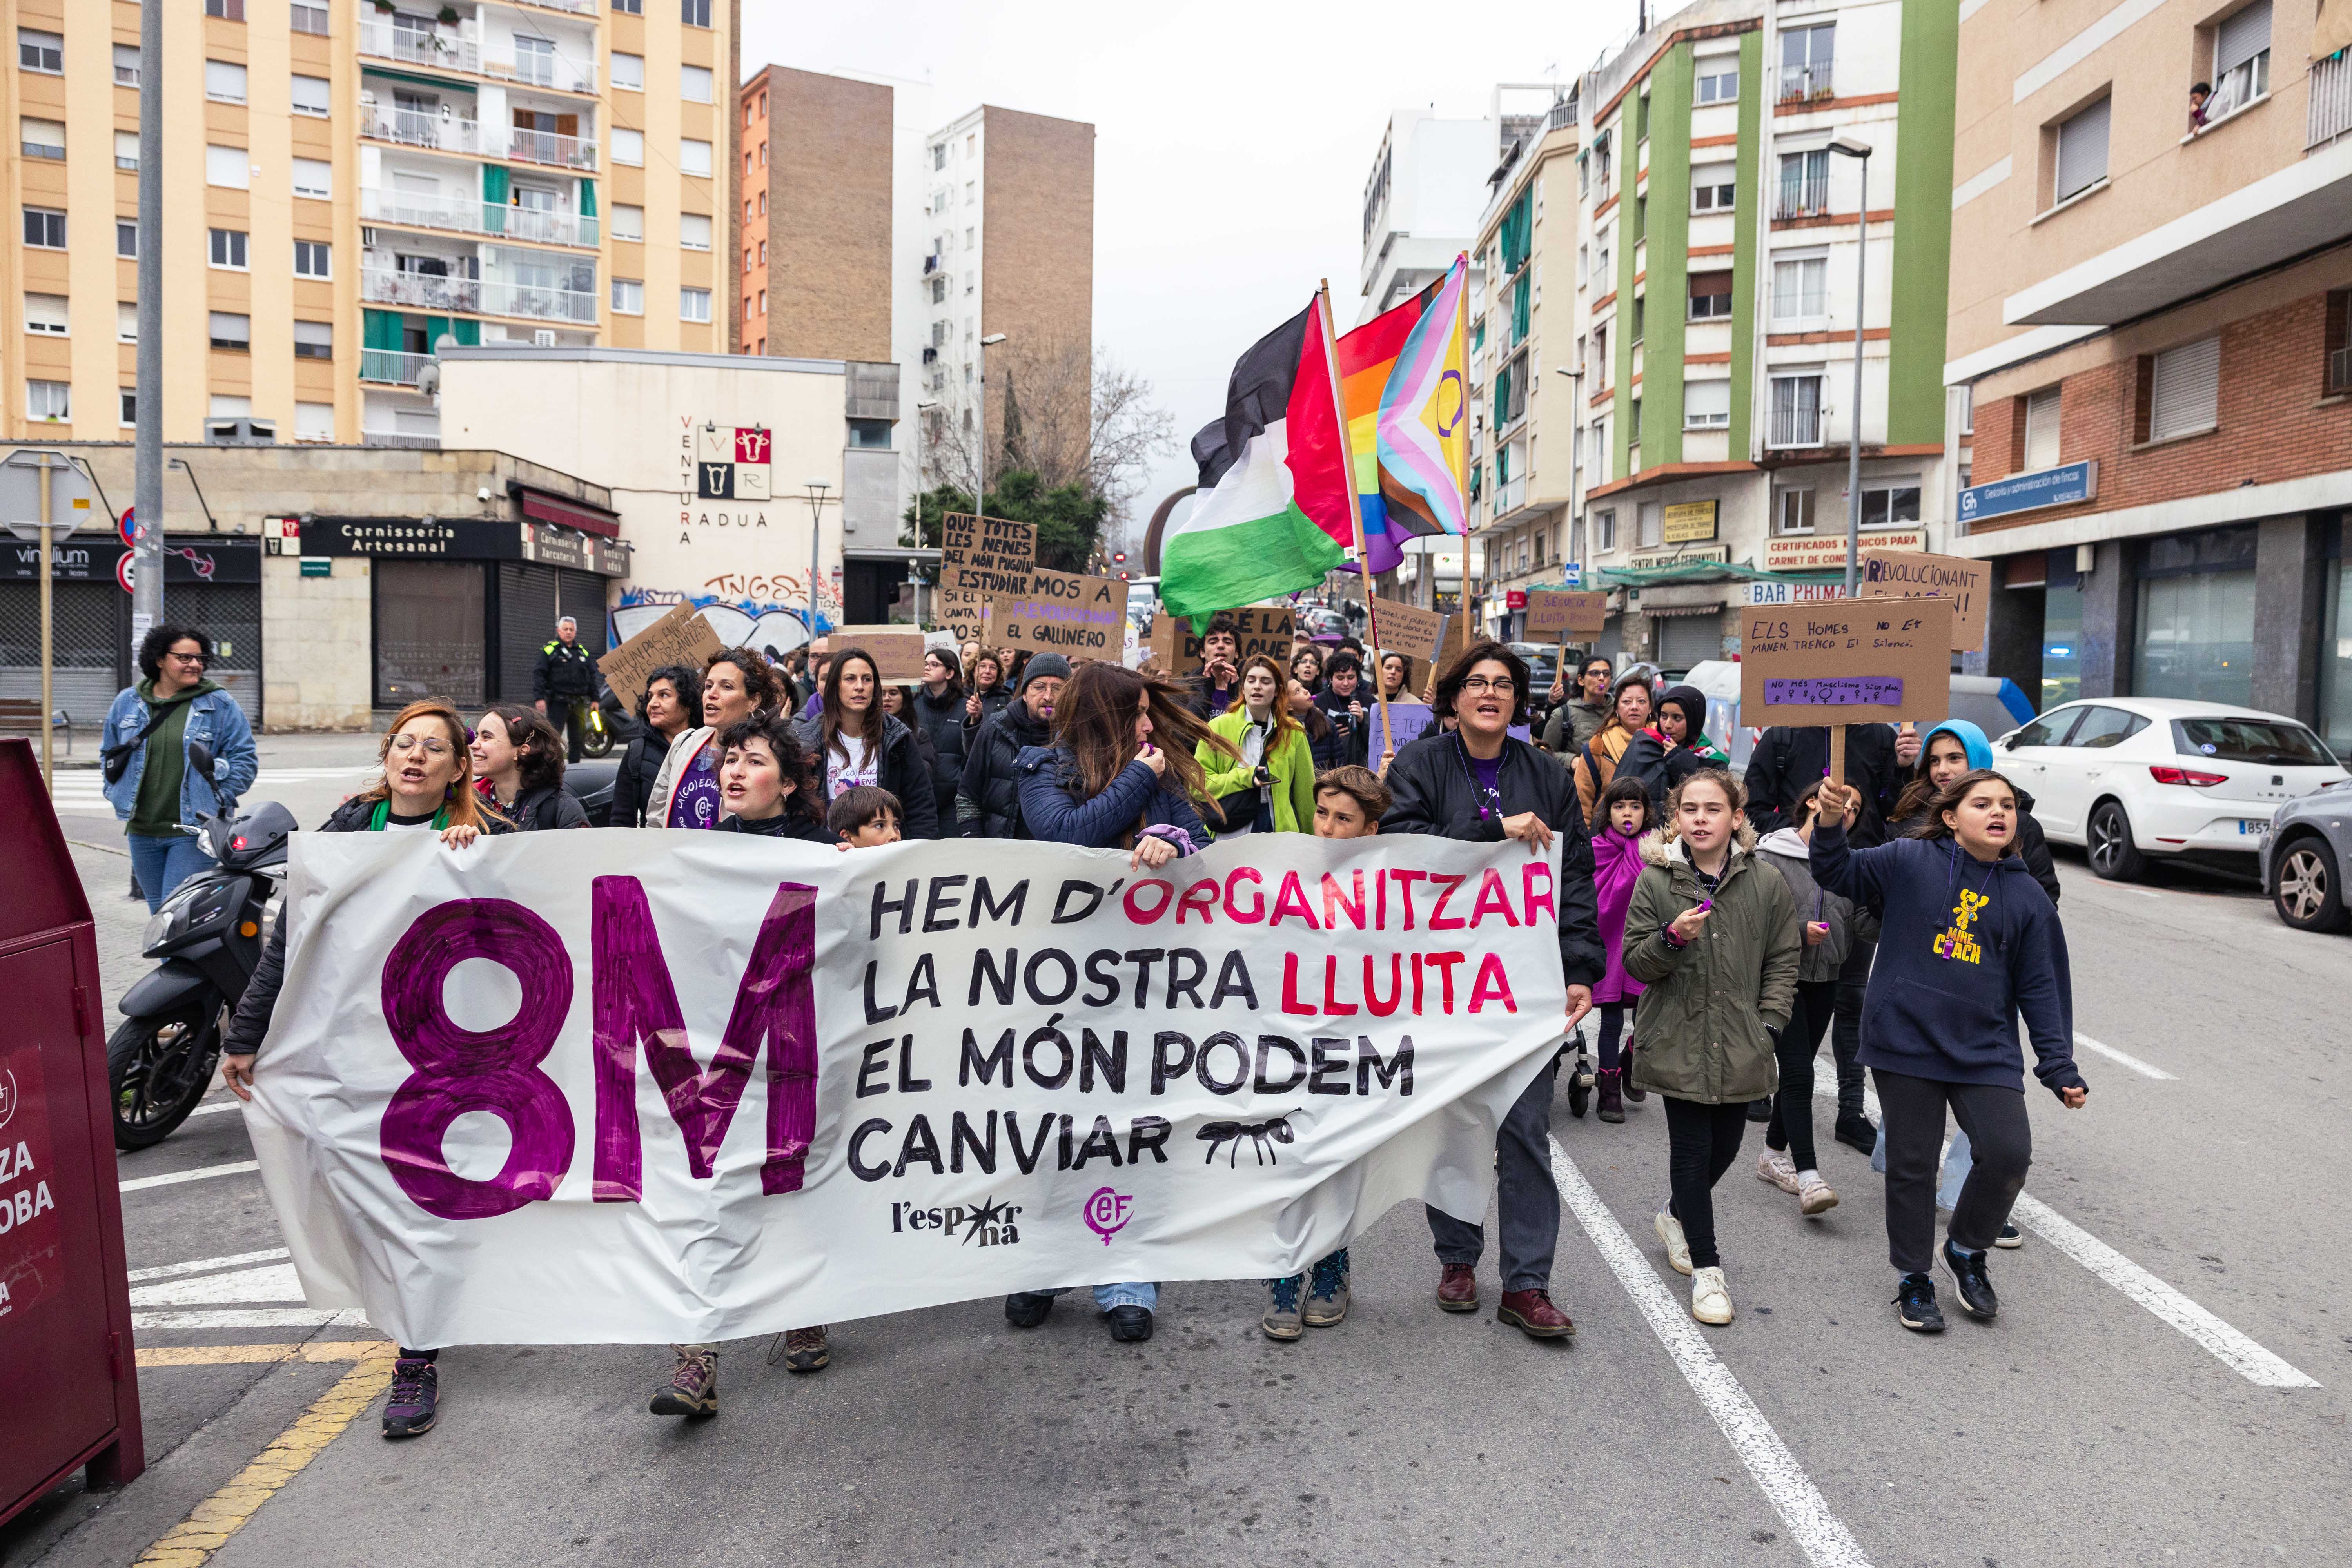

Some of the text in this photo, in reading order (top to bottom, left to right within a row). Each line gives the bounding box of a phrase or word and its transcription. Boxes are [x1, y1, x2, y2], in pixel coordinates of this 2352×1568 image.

[341, 524, 454, 538] Carnisseria
[946, 515, 1032, 540] QUE TOTES
[352, 539, 445, 552] Artesanal
[946, 532, 1031, 555] LES NENES
[1771, 535, 1918, 552] CERTIFICADOS MDICOS PARA
[16, 545, 89, 564] vinlium
[944, 550, 965, 564] DEL
[971, 552, 994, 569] MÓN
[1769, 555, 1804, 566] CARNET
[1808, 555, 1819, 564] DE
[958, 570, 1027, 595] ESTUDIAR
[945, 589, 957, 602] SI
[963, 591, 977, 603] EL
[1095, 584, 1111, 603] A
[1754, 583, 1786, 603] BAR
[1261, 614, 1293, 635] LA
[1386, 619, 1401, 628] teva
[1403, 624, 1421, 632] dona
[1409, 617, 1428, 626] plaer
[1751, 621, 1789, 639] ELS
[1876, 621, 1890, 630] NO
[1007, 624, 1021, 638] EL
[1033, 625, 1106, 648] GALLINERO
[1377, 628, 1392, 637] gual
[1246, 639, 1290, 661] QUE
[870, 862, 1557, 940] HEM D'ORGANITZAR
[1946, 927, 1974, 946] MIKE
[1933, 934, 1981, 964] CACK
[864, 947, 1517, 1025] LA NOSTRA LLUITA
[380, 875, 818, 1220] 8M
[856, 1013, 1415, 1099] EL MÓN PODEM
[847, 1109, 1172, 1183] CANVIAR
